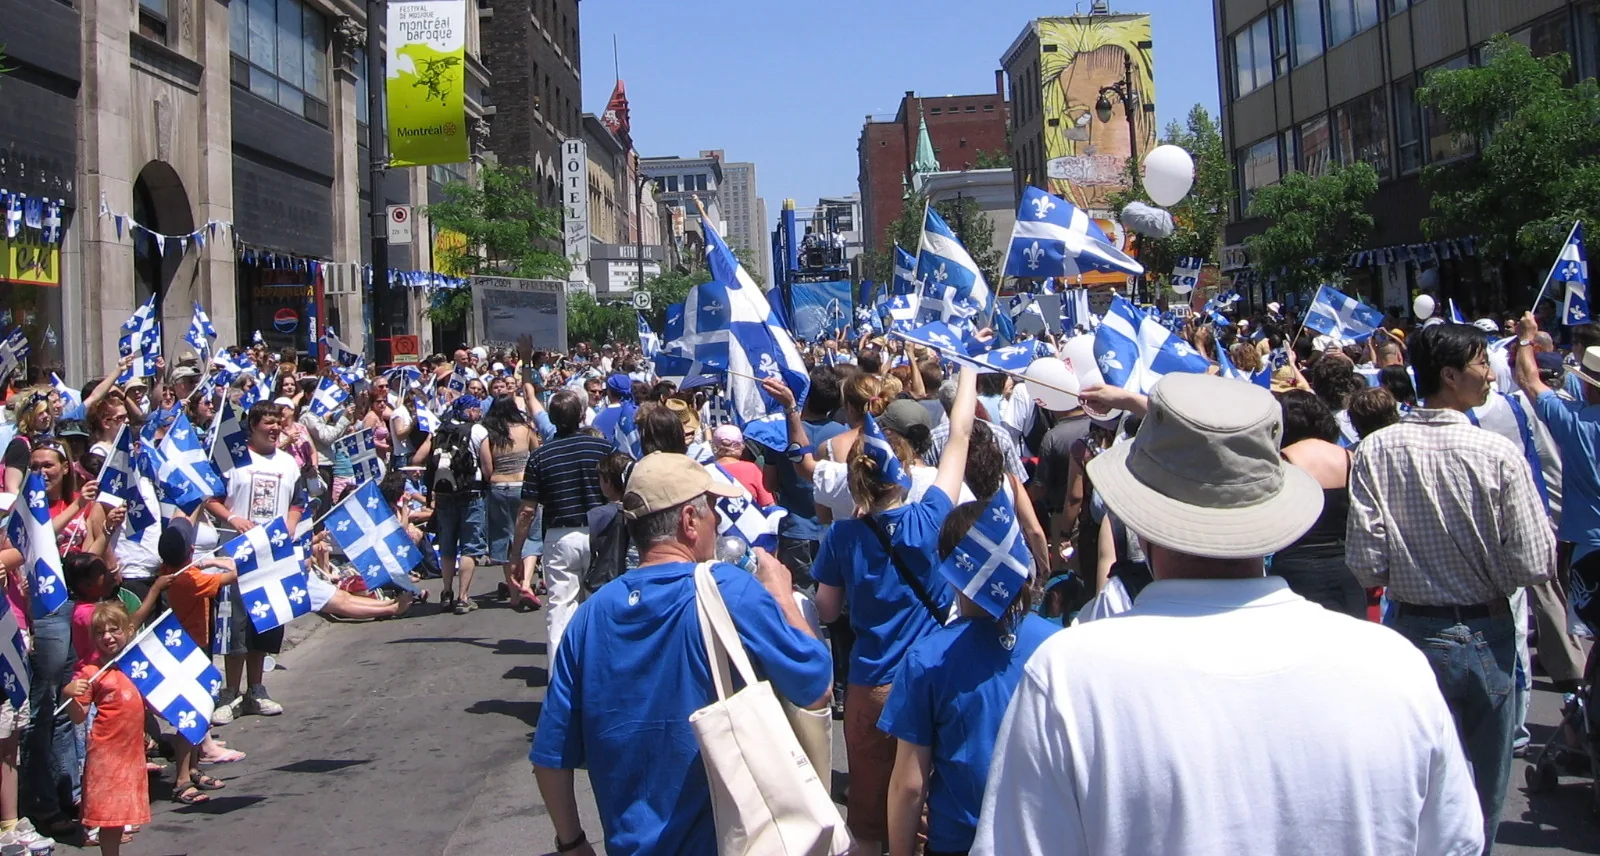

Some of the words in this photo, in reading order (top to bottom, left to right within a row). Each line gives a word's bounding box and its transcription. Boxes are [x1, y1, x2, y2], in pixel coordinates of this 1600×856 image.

[400, 16, 450, 32] montréal
[406, 29, 452, 41] baroque
[397, 125, 443, 137] Montréal
[567, 143, 581, 219] HÔTEL
[619, 246, 652, 258] METROLIS
